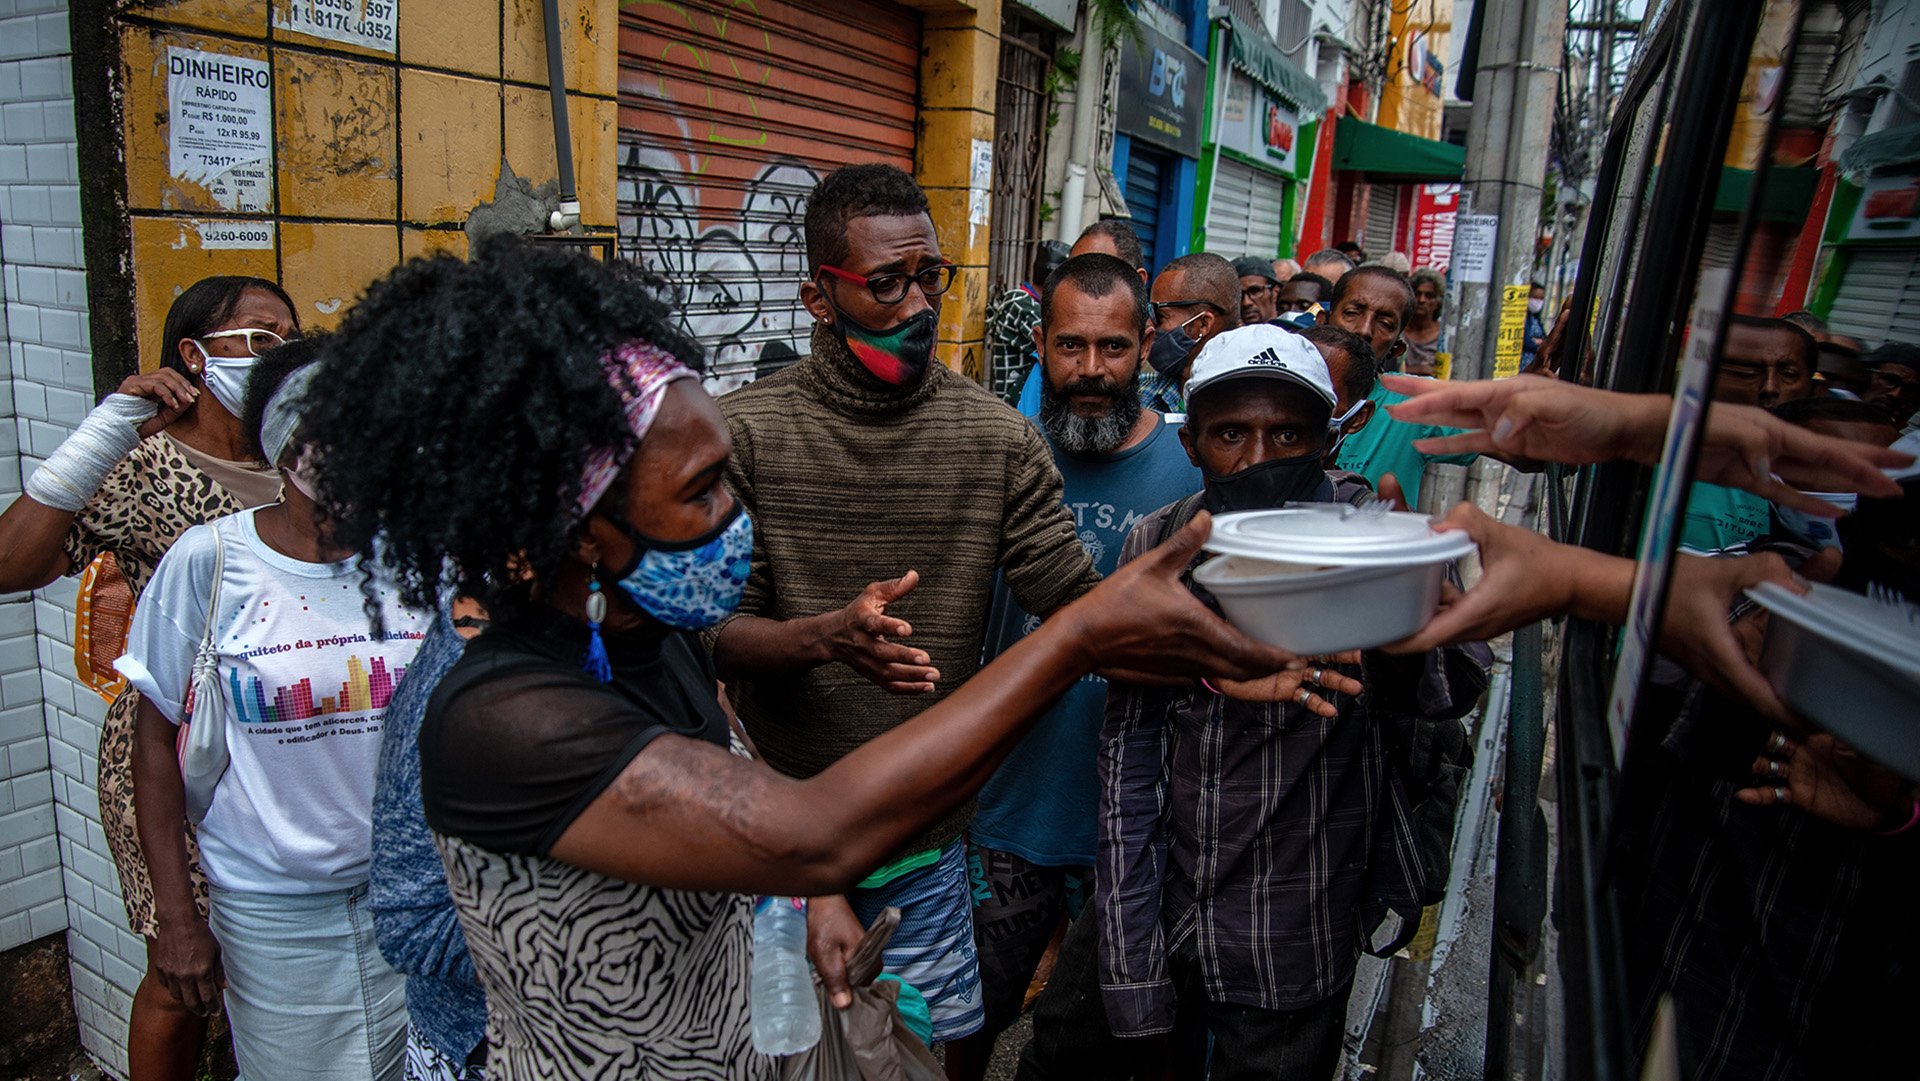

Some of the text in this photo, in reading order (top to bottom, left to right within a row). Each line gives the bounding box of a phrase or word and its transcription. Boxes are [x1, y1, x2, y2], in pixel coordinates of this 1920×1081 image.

[171, 56, 269, 89] DINHEIRO
[196, 85, 237, 102] RÁPIDO
[202, 111, 214, 122] R$
[216, 113, 248, 126] 1.000,00
[205, 231, 268, 242] 9260-6009
[1416, 213, 1434, 264] OGARIA
[1428, 211, 1457, 274] SQUINA
[1248, 359, 1287, 368] adidas
[235, 644, 292, 661] rquiteto
[295, 639, 313, 650] da
[316, 633, 367, 649] própria
[248, 727, 254, 735] A
[255, 727, 283, 735] cidade
[285, 725, 303, 736] que
[304, 719, 321, 730] tem
[286, 730, 328, 744] edificador
[339, 727, 364, 736] Deus.
